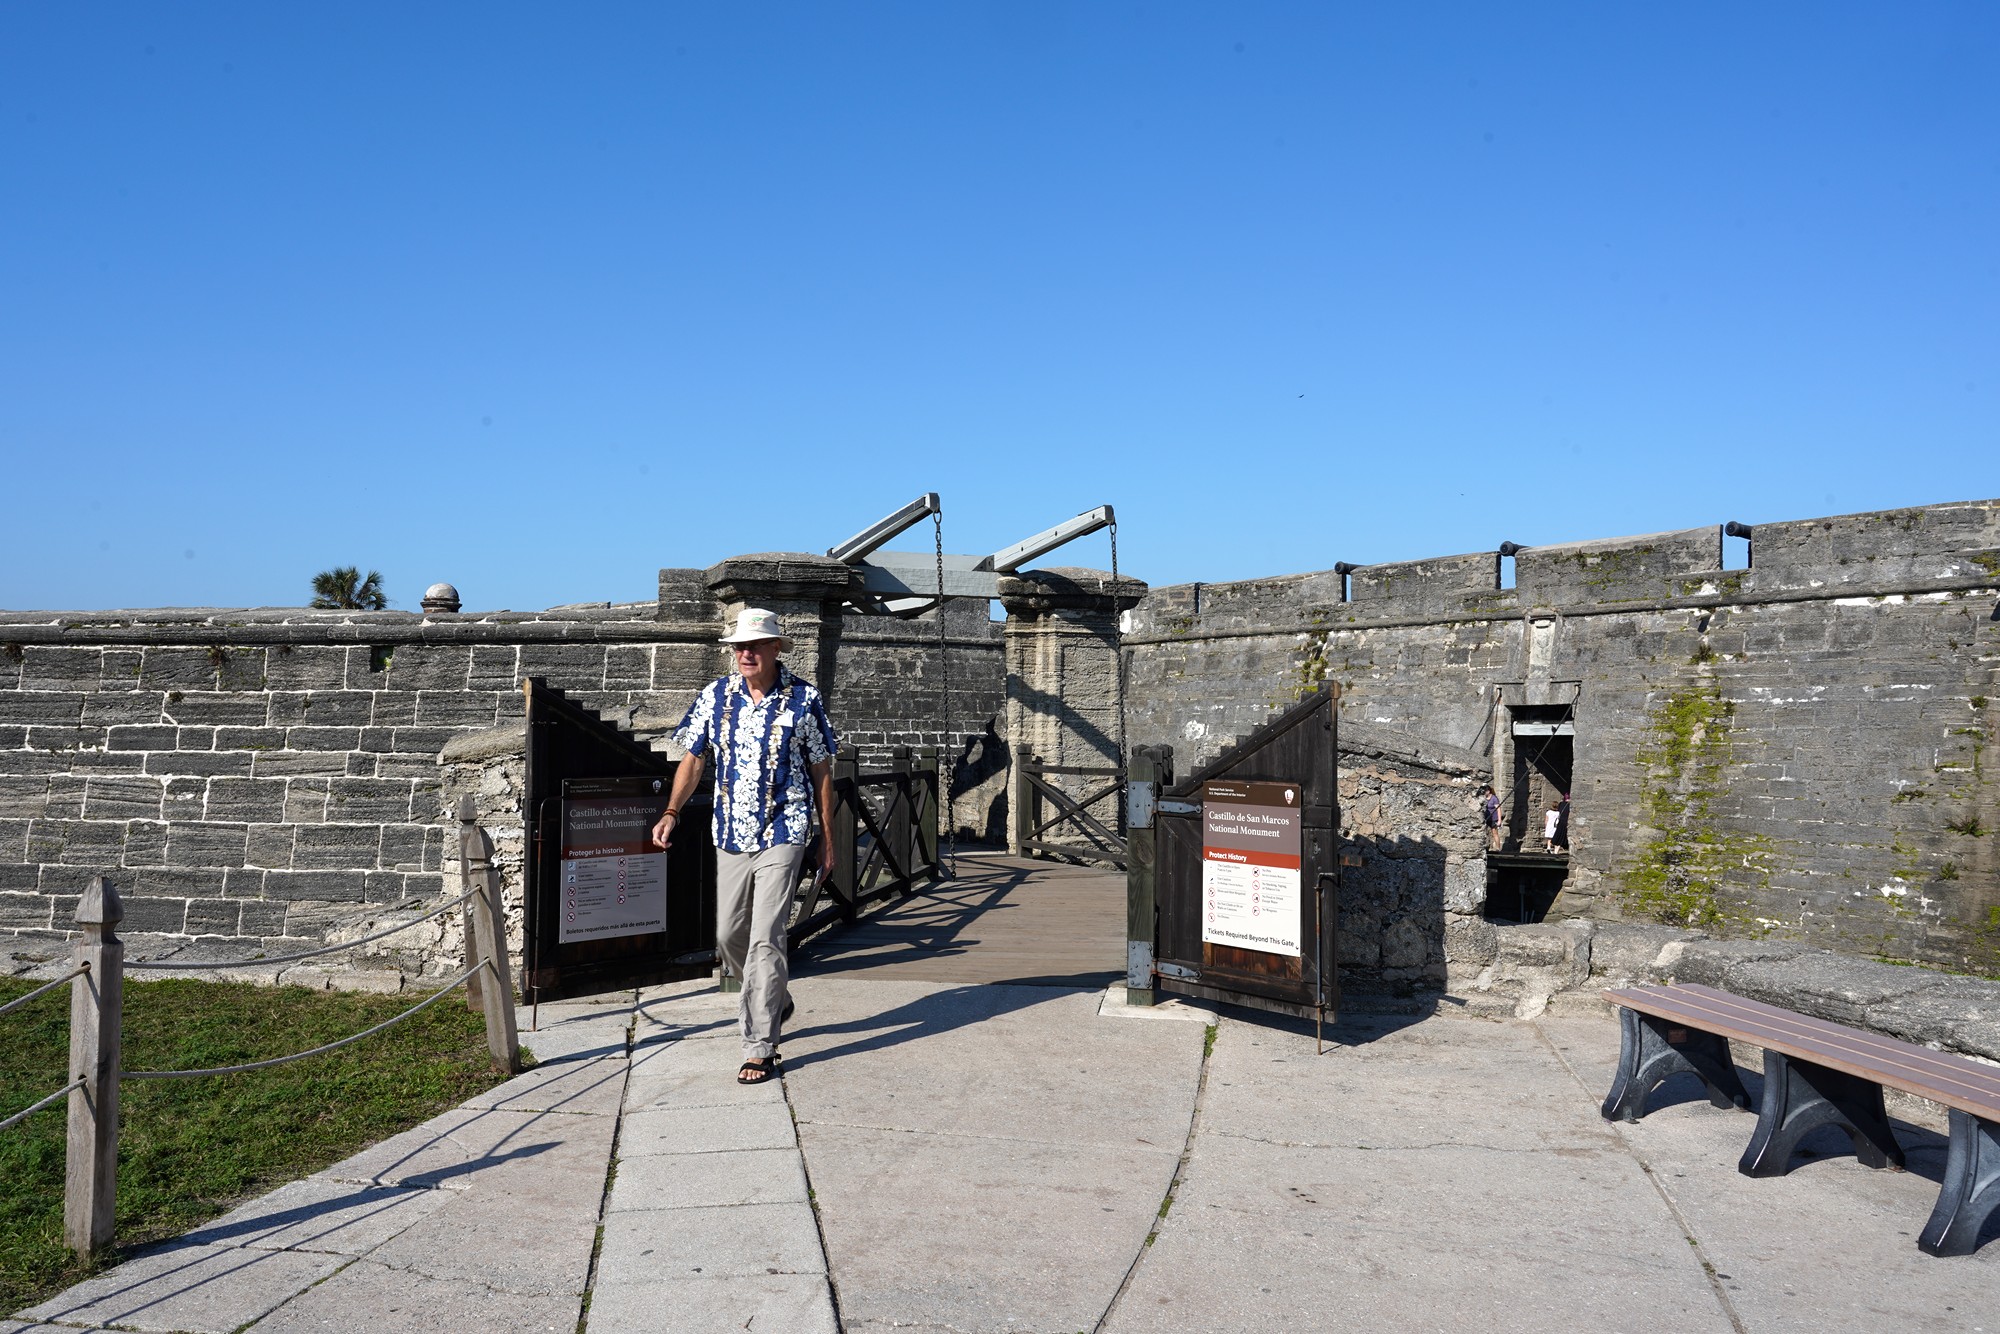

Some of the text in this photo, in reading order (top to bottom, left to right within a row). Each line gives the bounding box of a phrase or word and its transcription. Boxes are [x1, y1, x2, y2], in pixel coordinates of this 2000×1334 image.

[569, 806, 657, 818] Castillo de San Marcos
[569, 819, 647, 830] National Monument
[1208, 811, 1290, 826] Castillo de San Marcos
[1208, 823, 1280, 838] National Monument
[569, 849, 594, 858] Proteger
[1208, 851, 1247, 863] Protect History
[585, 925, 609, 933] requeridos
[1208, 927, 1294, 947] Tickets Required Beyond This Gate
